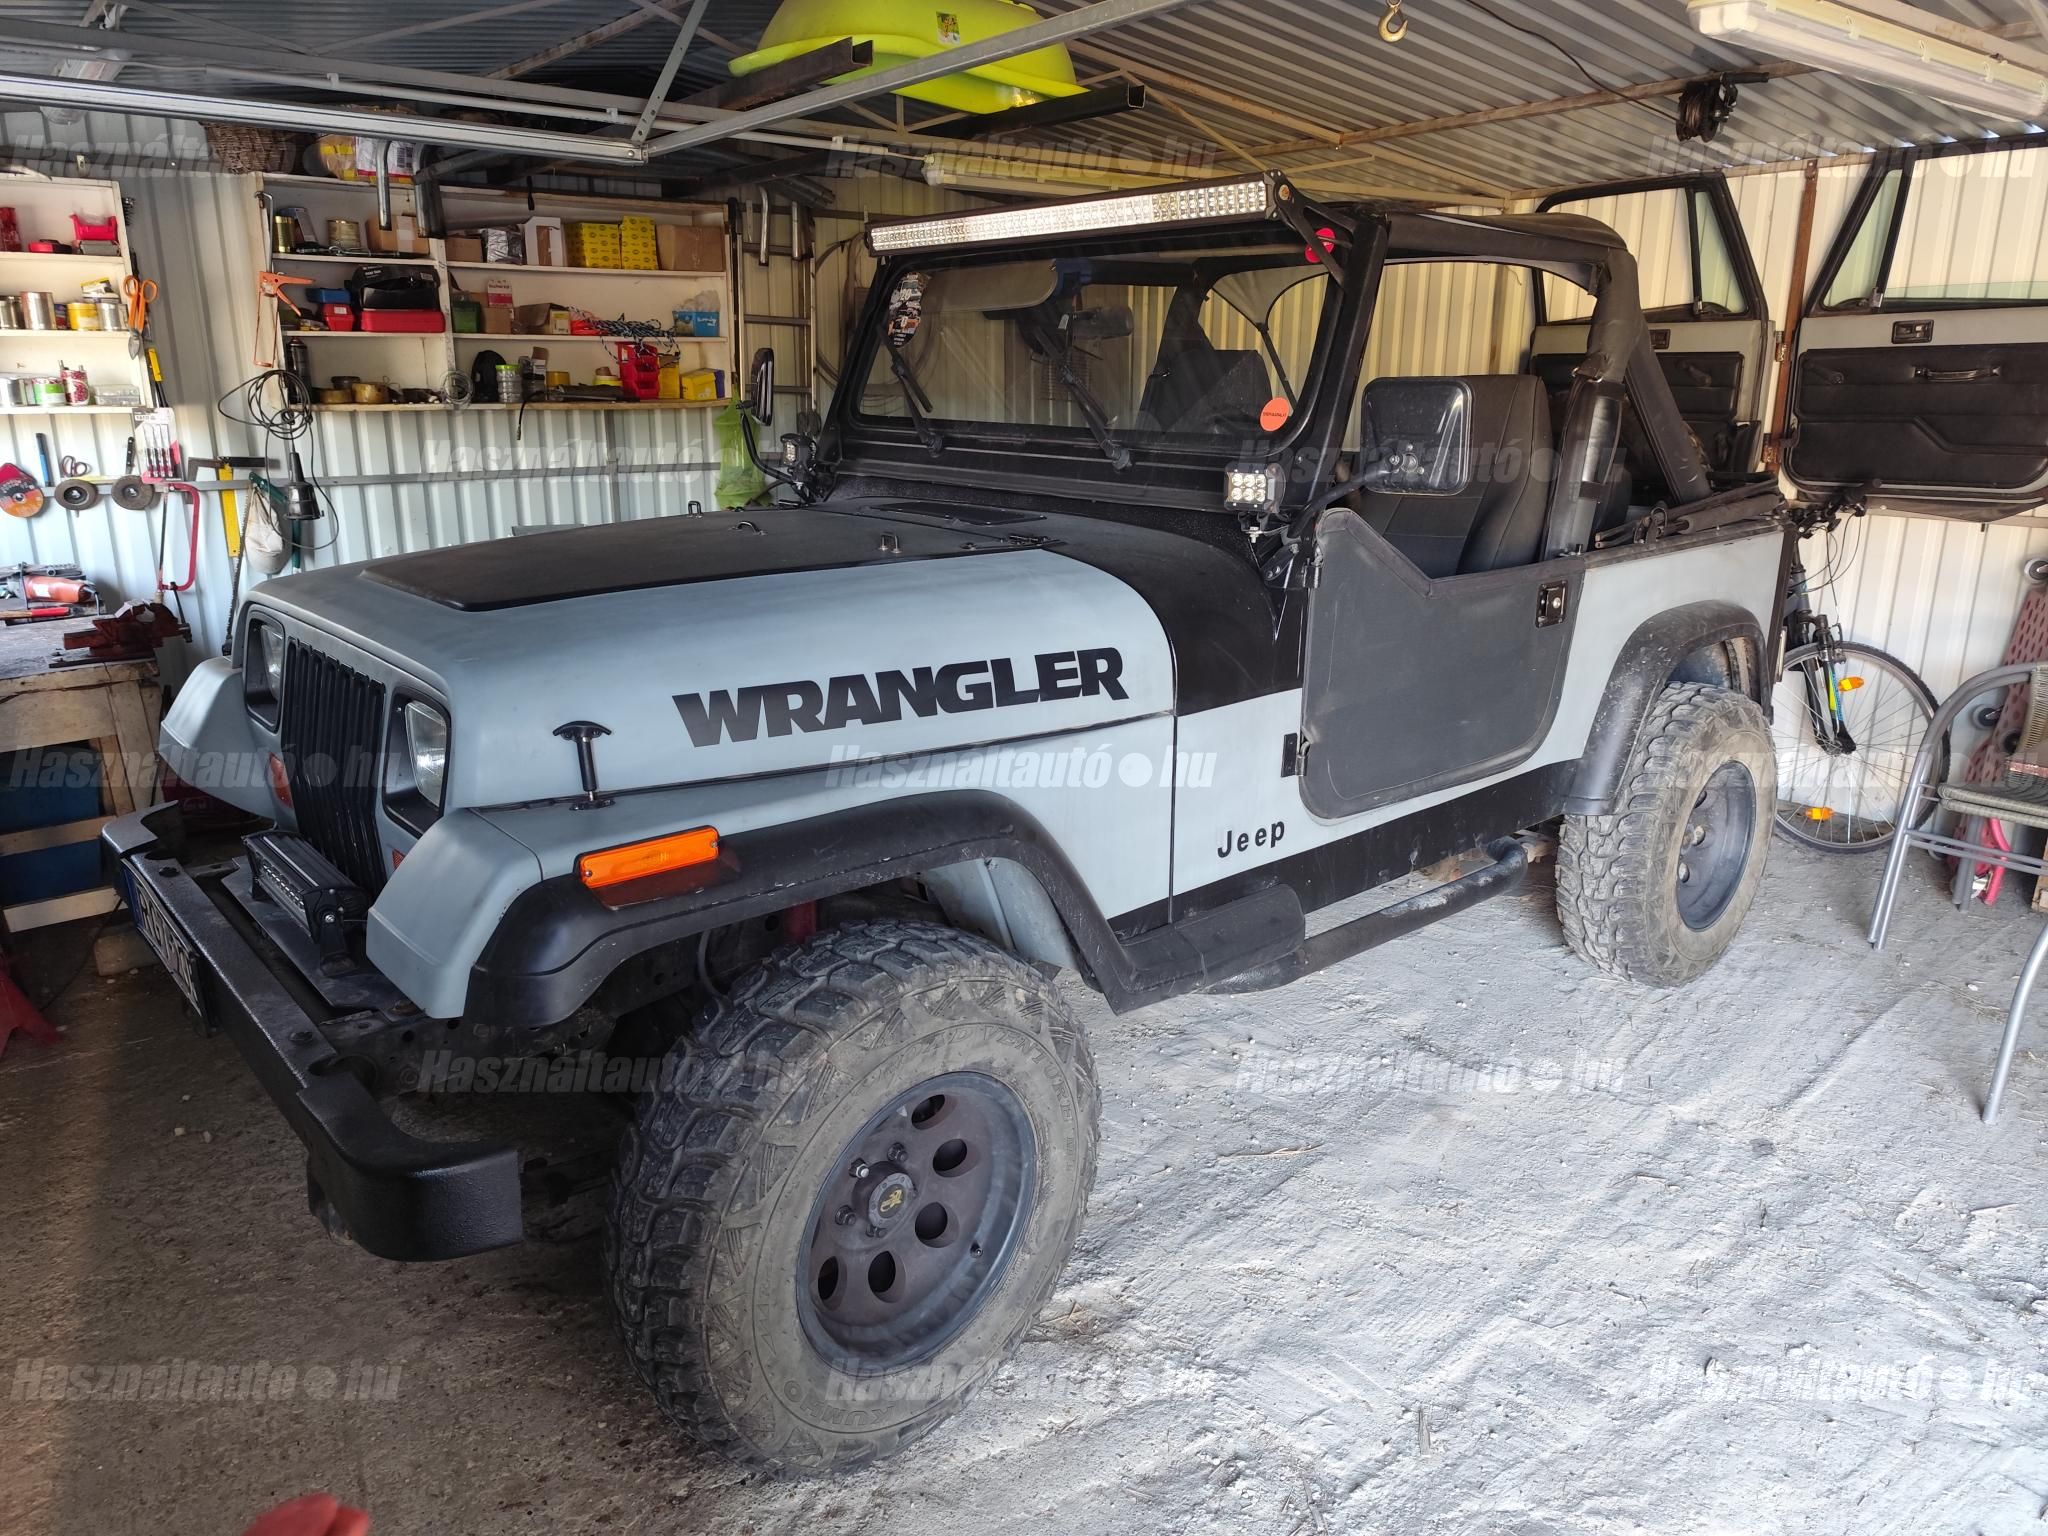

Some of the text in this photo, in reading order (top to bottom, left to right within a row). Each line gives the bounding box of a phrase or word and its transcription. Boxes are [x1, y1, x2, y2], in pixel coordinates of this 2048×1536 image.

[672, 646, 1129, 748] WRANGLER
[1217, 820, 1285, 858] Jeep
[783, 1379, 895, 1426] KUMHO
